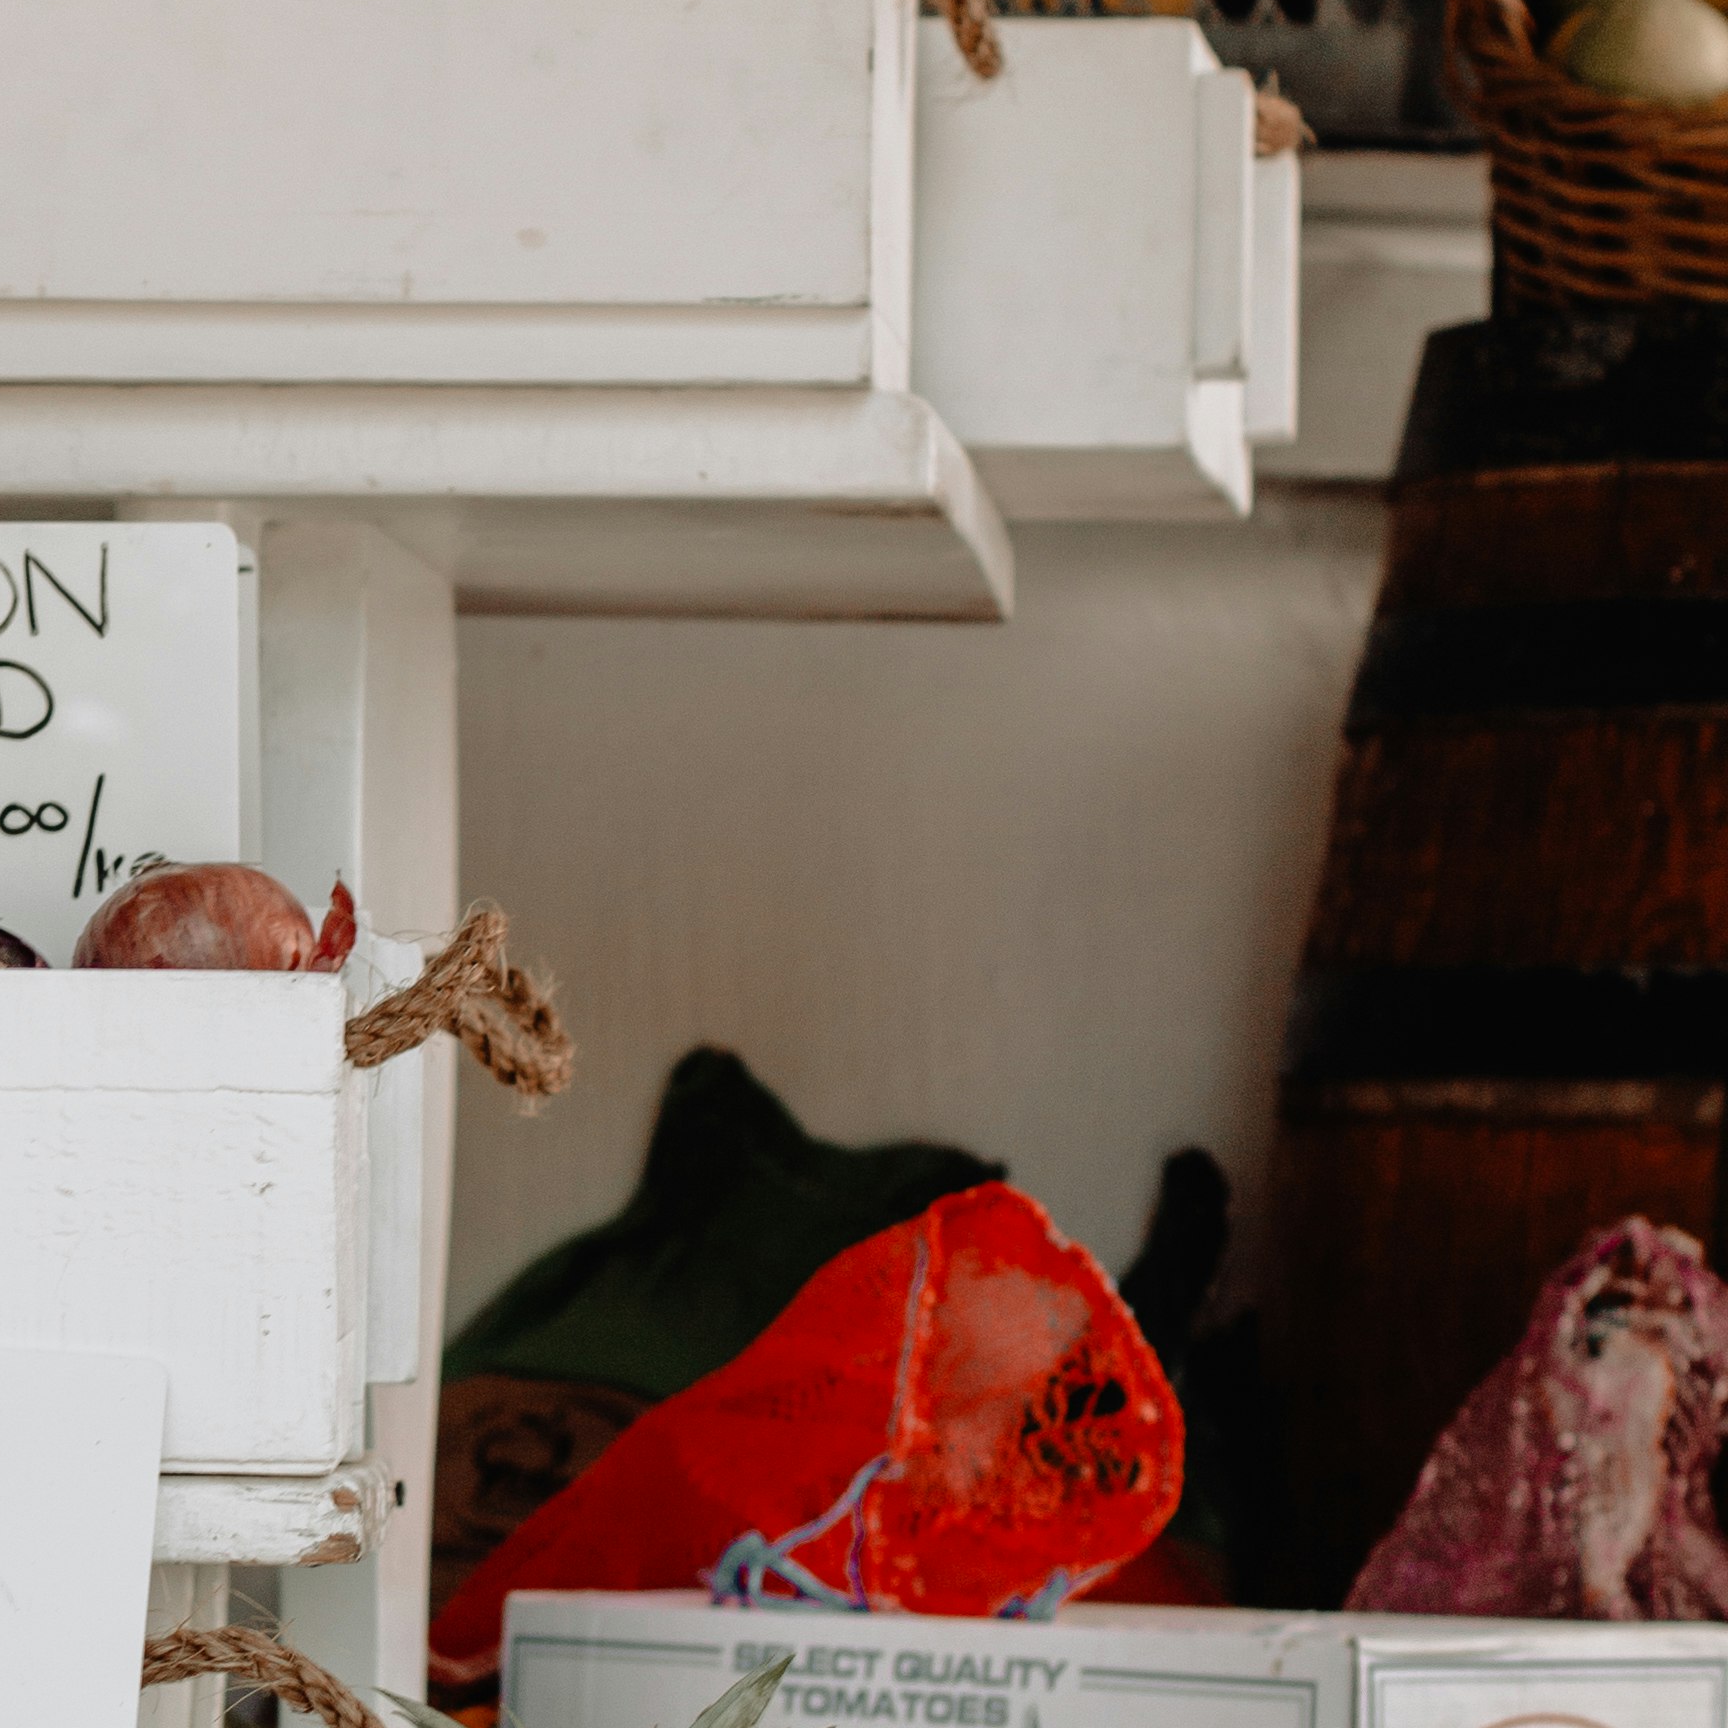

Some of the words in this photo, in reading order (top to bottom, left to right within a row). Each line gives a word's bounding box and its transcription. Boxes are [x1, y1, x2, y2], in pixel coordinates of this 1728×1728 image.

[732, 1642, 884, 1681] SELECT
[891, 1648, 1070, 1692] QUALITY
[779, 1682, 1010, 1728] TOMATOES
